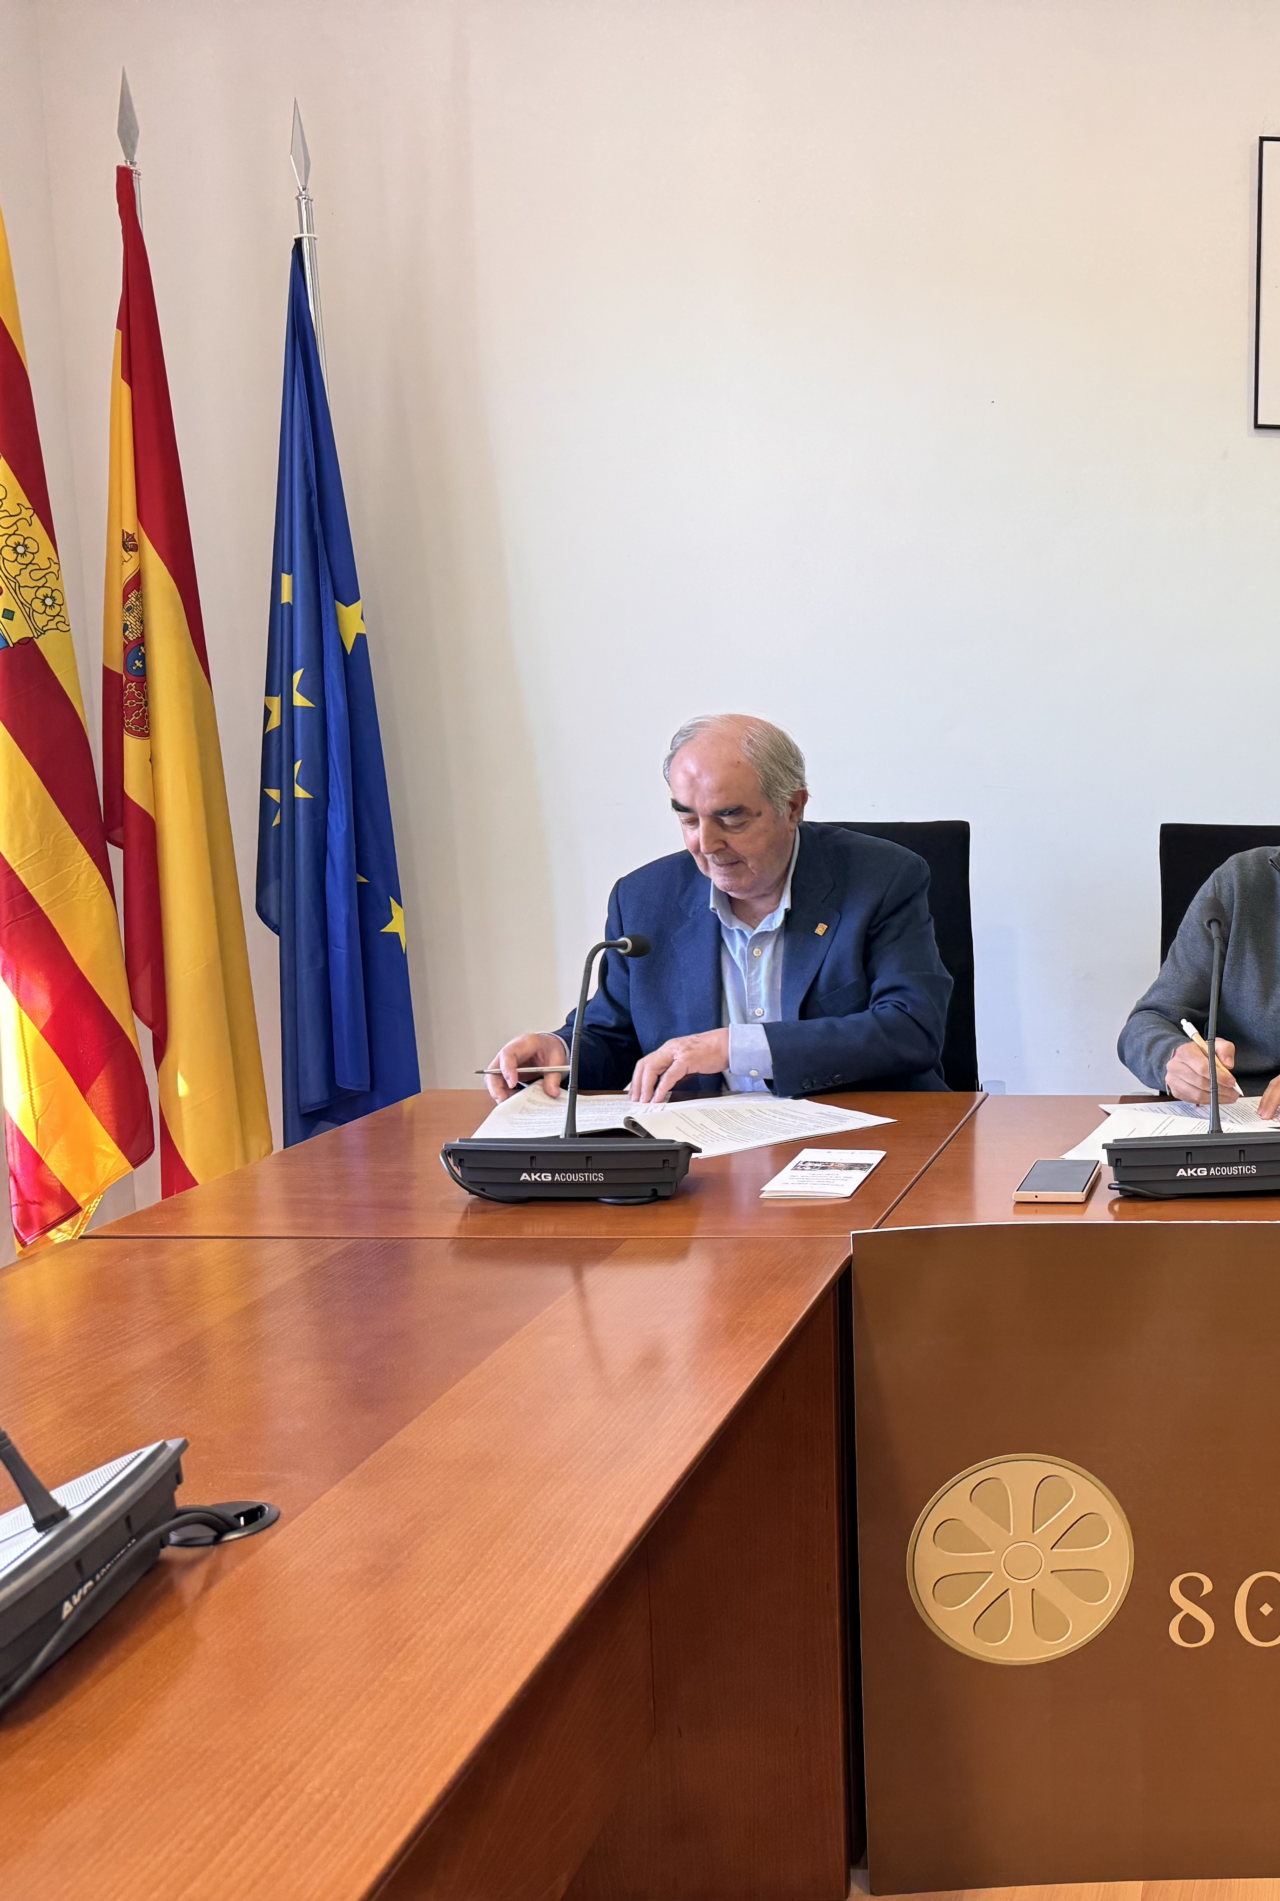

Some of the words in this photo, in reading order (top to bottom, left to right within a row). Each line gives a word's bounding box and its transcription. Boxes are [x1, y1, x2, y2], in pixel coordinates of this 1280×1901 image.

[1175, 1167, 1208, 1177] AKG
[1209, 1165, 1257, 1176] ACOUSTICS
[519, 1172, 552, 1182] AKG
[554, 1172, 605, 1182] ACOUSTICS
